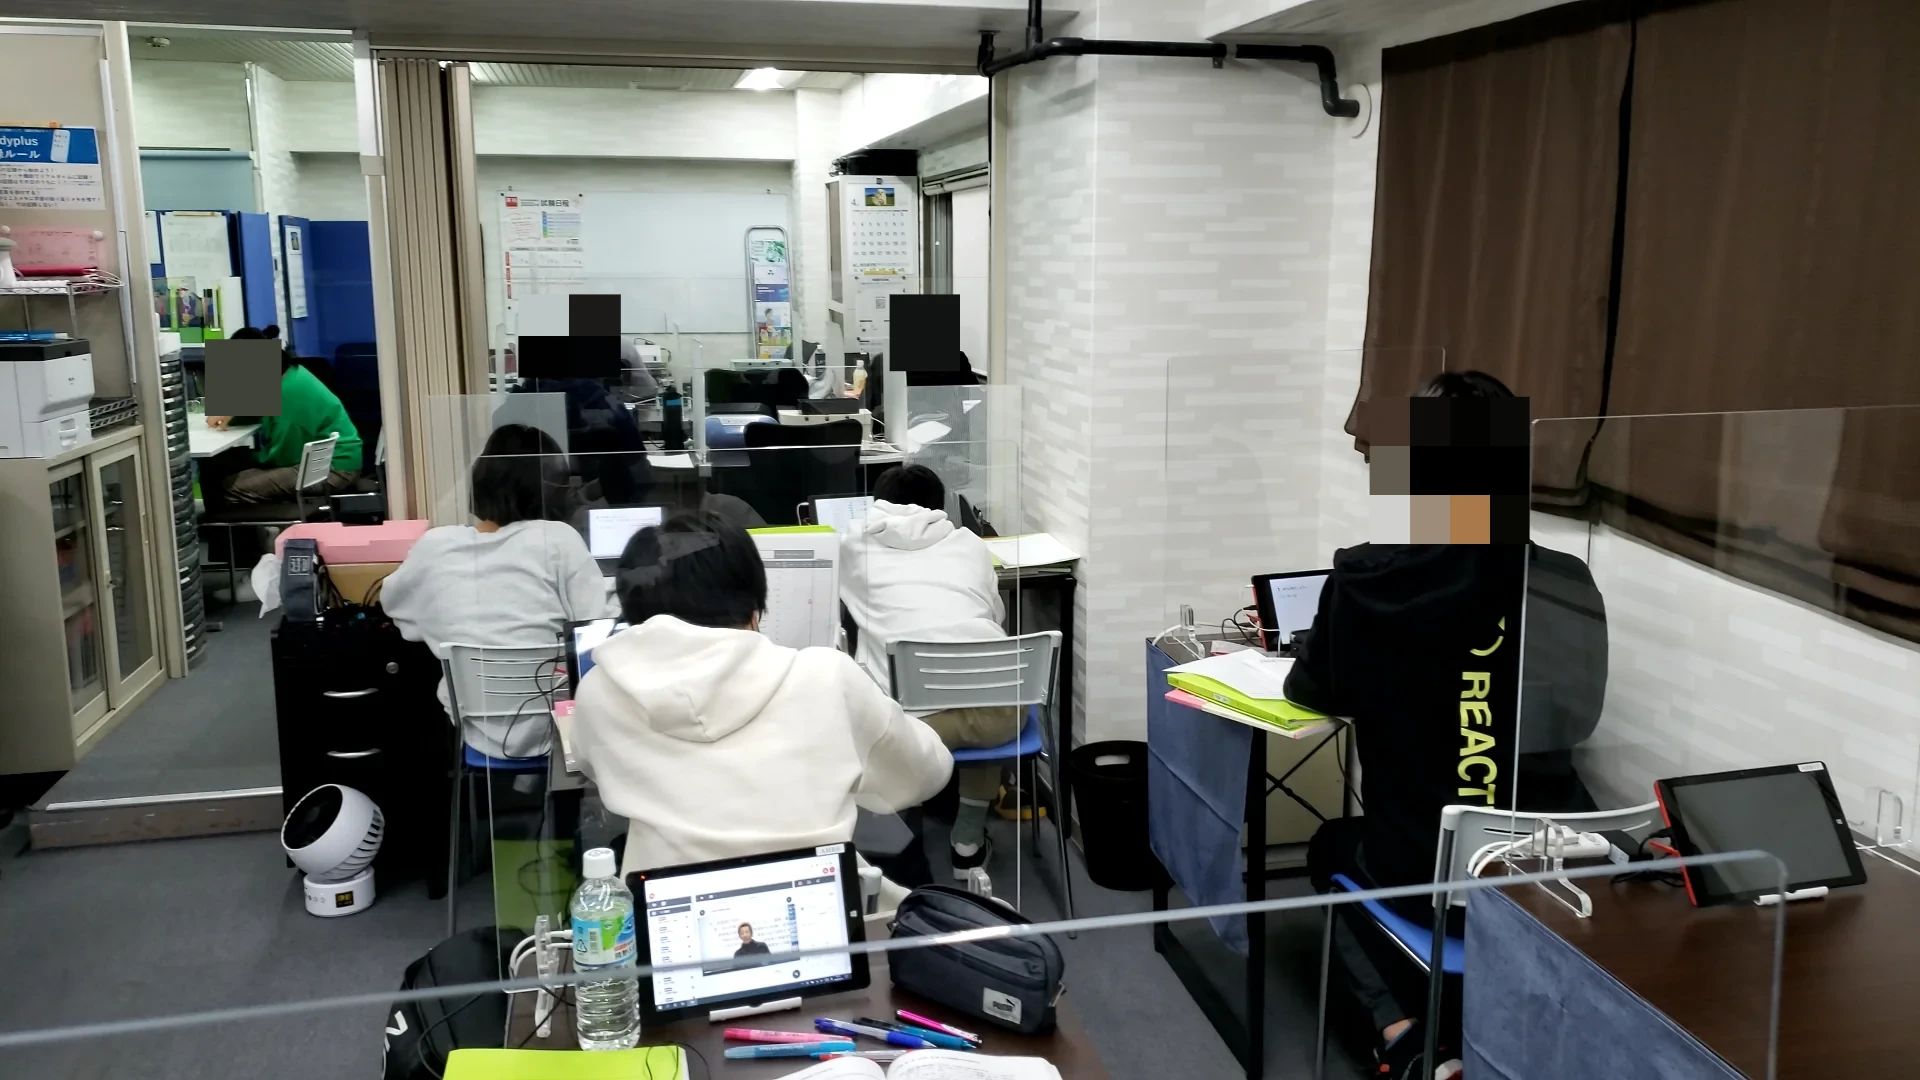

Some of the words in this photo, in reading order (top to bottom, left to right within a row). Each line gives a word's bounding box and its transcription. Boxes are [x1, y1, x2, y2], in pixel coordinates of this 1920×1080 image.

[541, 199, 569, 207] 試験日程
[1457, 671, 1498, 809] REACT
